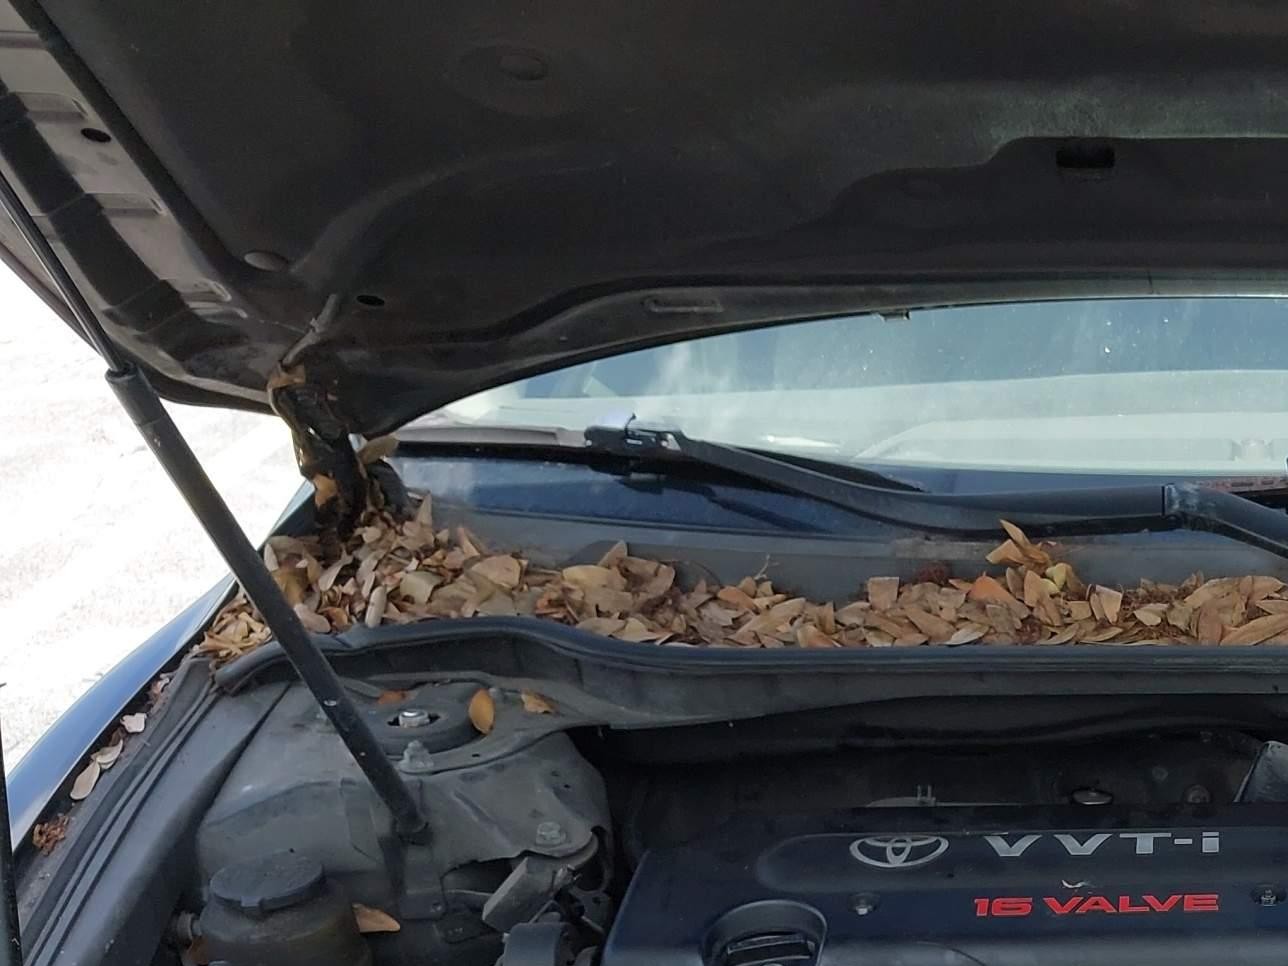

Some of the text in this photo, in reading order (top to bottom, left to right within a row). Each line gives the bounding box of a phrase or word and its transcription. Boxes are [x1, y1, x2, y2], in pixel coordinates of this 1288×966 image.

[985, 832, 1220, 857] VVT-i
[975, 893, 1219, 916] 16 VALVE
